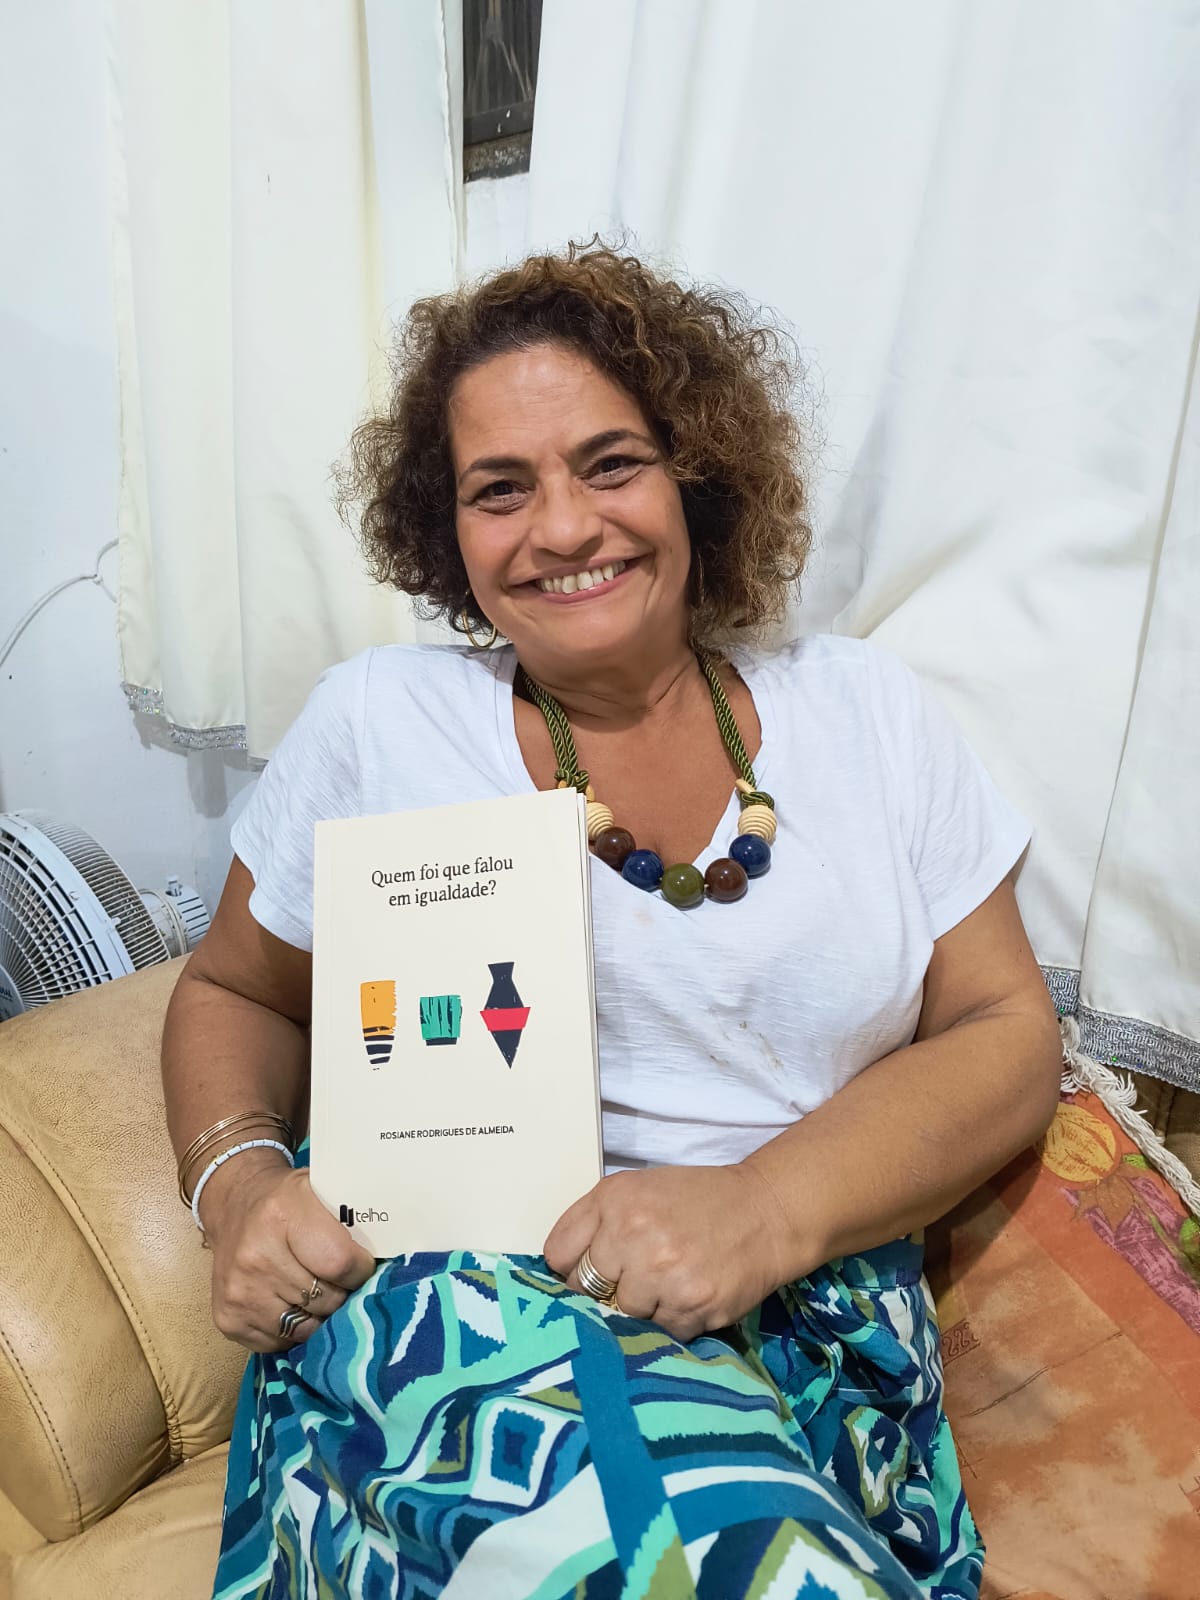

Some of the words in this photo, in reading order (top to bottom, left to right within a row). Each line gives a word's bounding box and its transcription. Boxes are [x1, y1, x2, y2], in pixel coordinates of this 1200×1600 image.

[371, 870, 416, 888] Quem
[419, 863, 439, 881] foi
[442, 863, 470, 881] que
[474, 856, 513, 874] falou
[389, 894, 411, 906] em
[415, 879, 497, 907] igualdade?
[380, 1130, 416, 1140] ROSIANE
[416, 1127, 464, 1138] RODRIGUES
[465, 1127, 477, 1136] DE
[478, 1125, 514, 1135] ALMEIDA
[355, 1207, 389, 1222] telha
